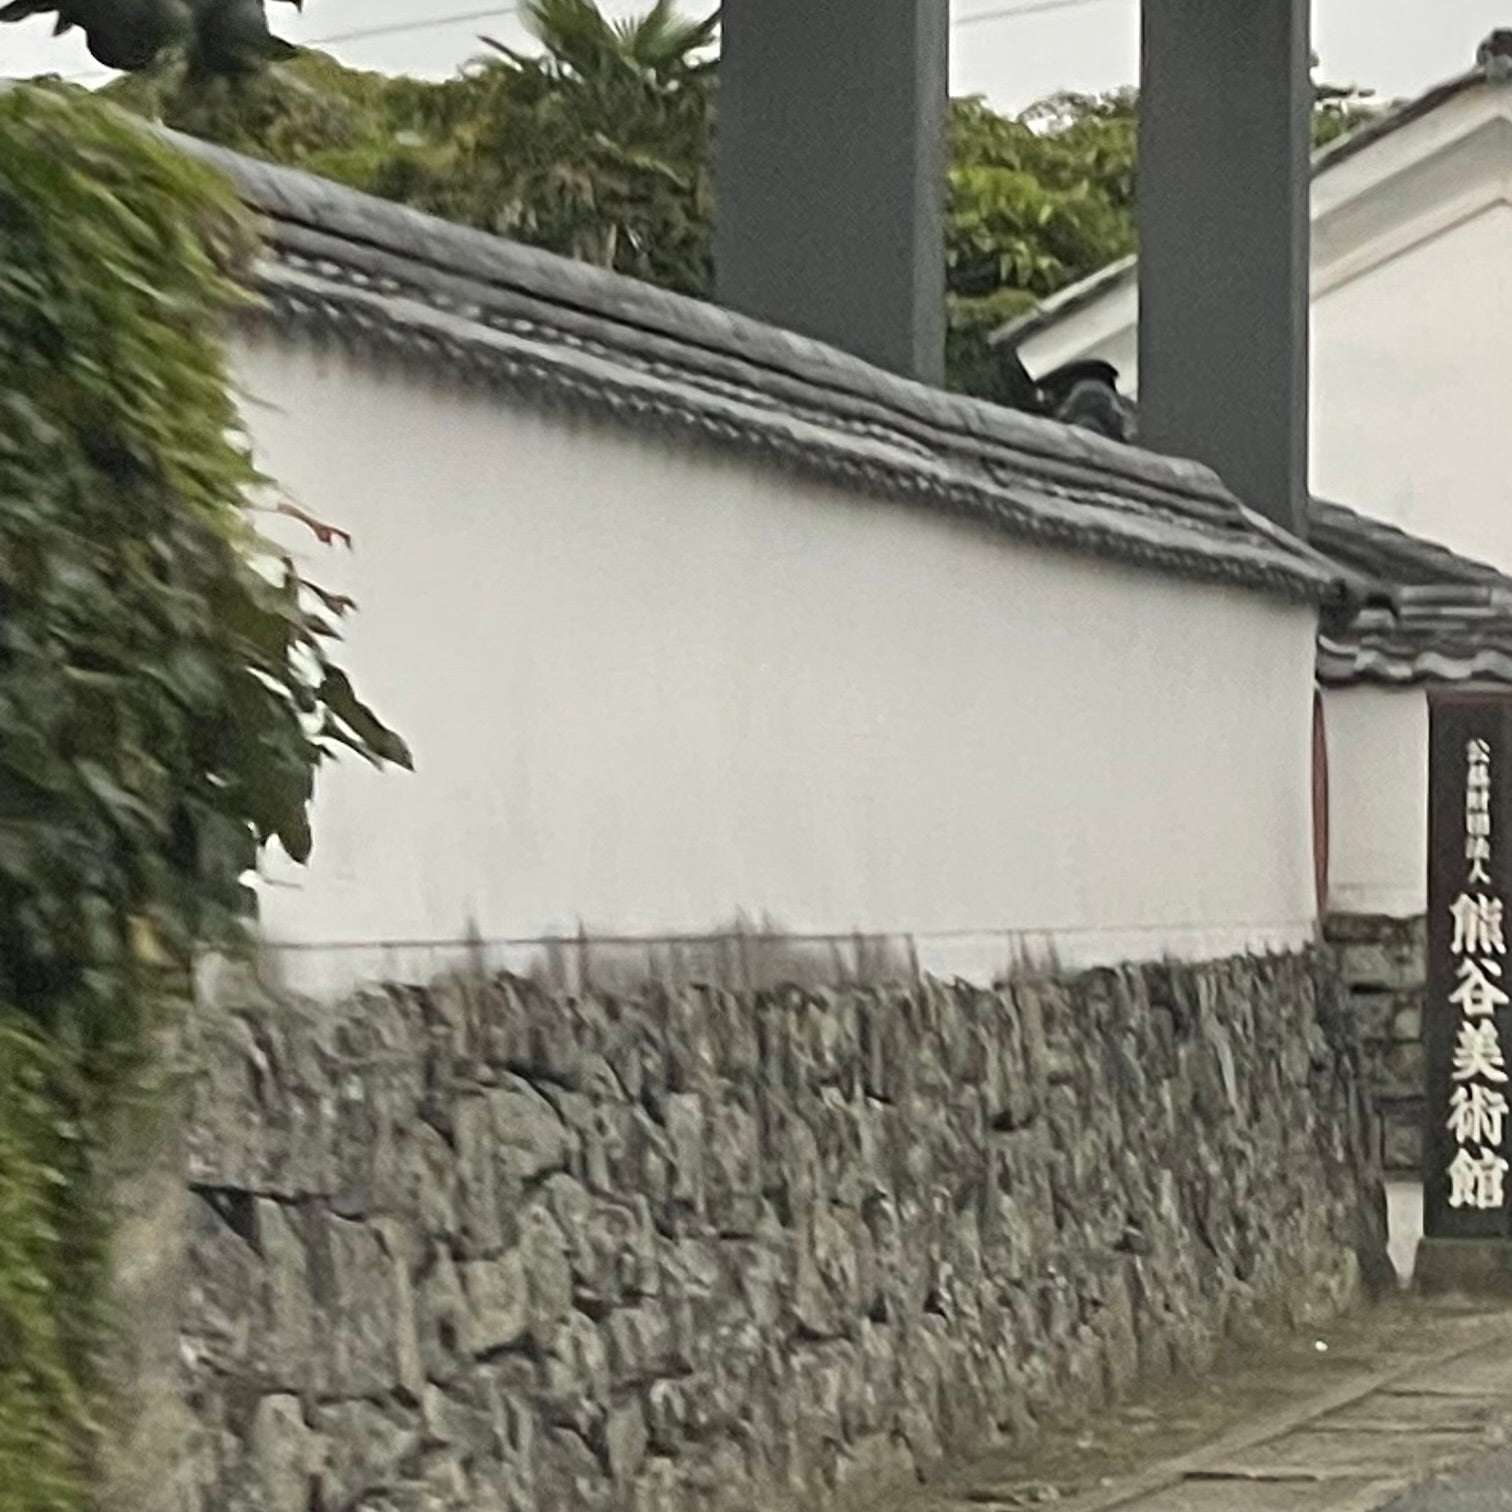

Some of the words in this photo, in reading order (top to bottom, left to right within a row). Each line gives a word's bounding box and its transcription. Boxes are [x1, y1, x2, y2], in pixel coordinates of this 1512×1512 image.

[1448, 892, 1509, 1209] 熊谷美術館
